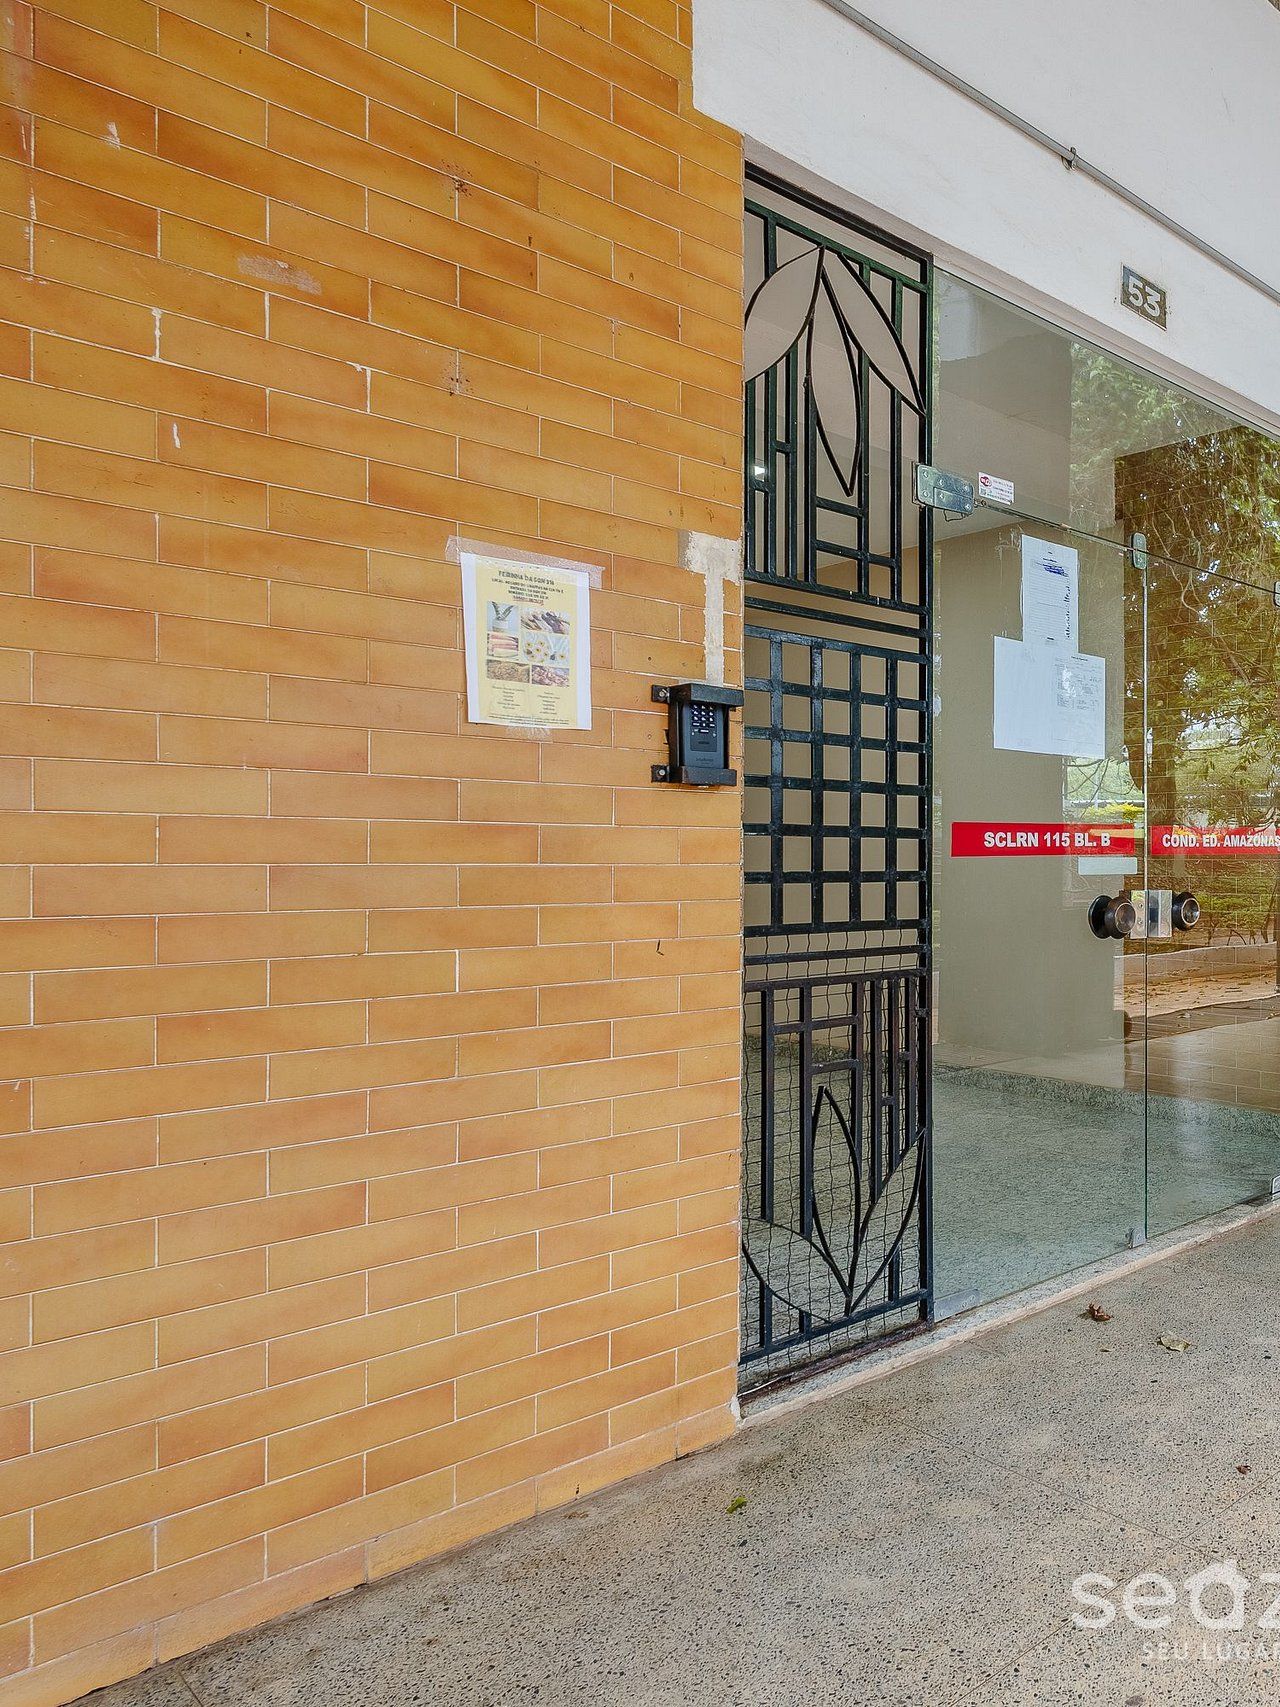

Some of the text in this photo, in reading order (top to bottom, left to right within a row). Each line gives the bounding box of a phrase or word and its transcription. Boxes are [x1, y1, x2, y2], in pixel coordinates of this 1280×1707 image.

[1128, 275, 1161, 317] 53
[984, 831, 1110, 848] SCLRN 115 BL. B
[1162, 833, 1280, 848] COND. ED. AMAZONAS
